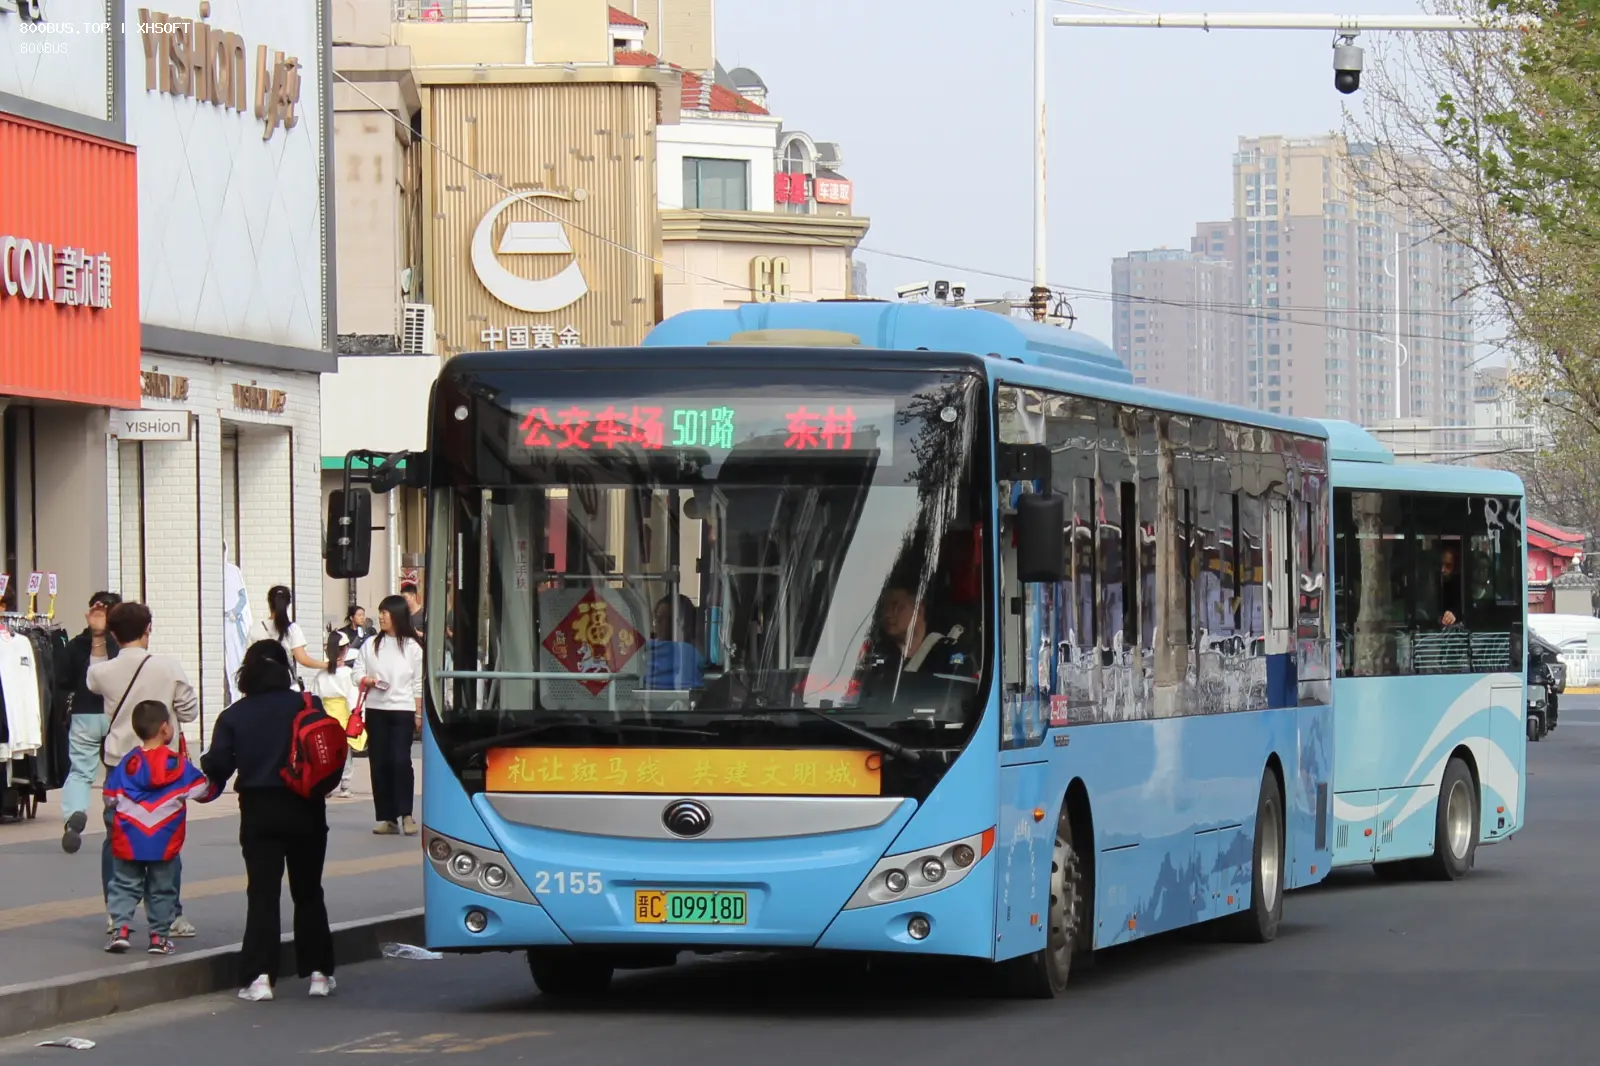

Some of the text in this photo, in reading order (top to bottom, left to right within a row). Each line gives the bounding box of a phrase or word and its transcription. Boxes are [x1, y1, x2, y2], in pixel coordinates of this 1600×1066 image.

[56, 246, 112, 309] 意尔康
[480, 324, 581, 350] 中国黄金
[519, 405, 856, 451] 公交车场 501路 东村
[571, 601, 614, 645] 福
[507, 755, 857, 788] 礼让斑马线 共建文明城
[535, 871, 602, 894] 2155
[637, 895, 744, 920] 晋C 09918D
